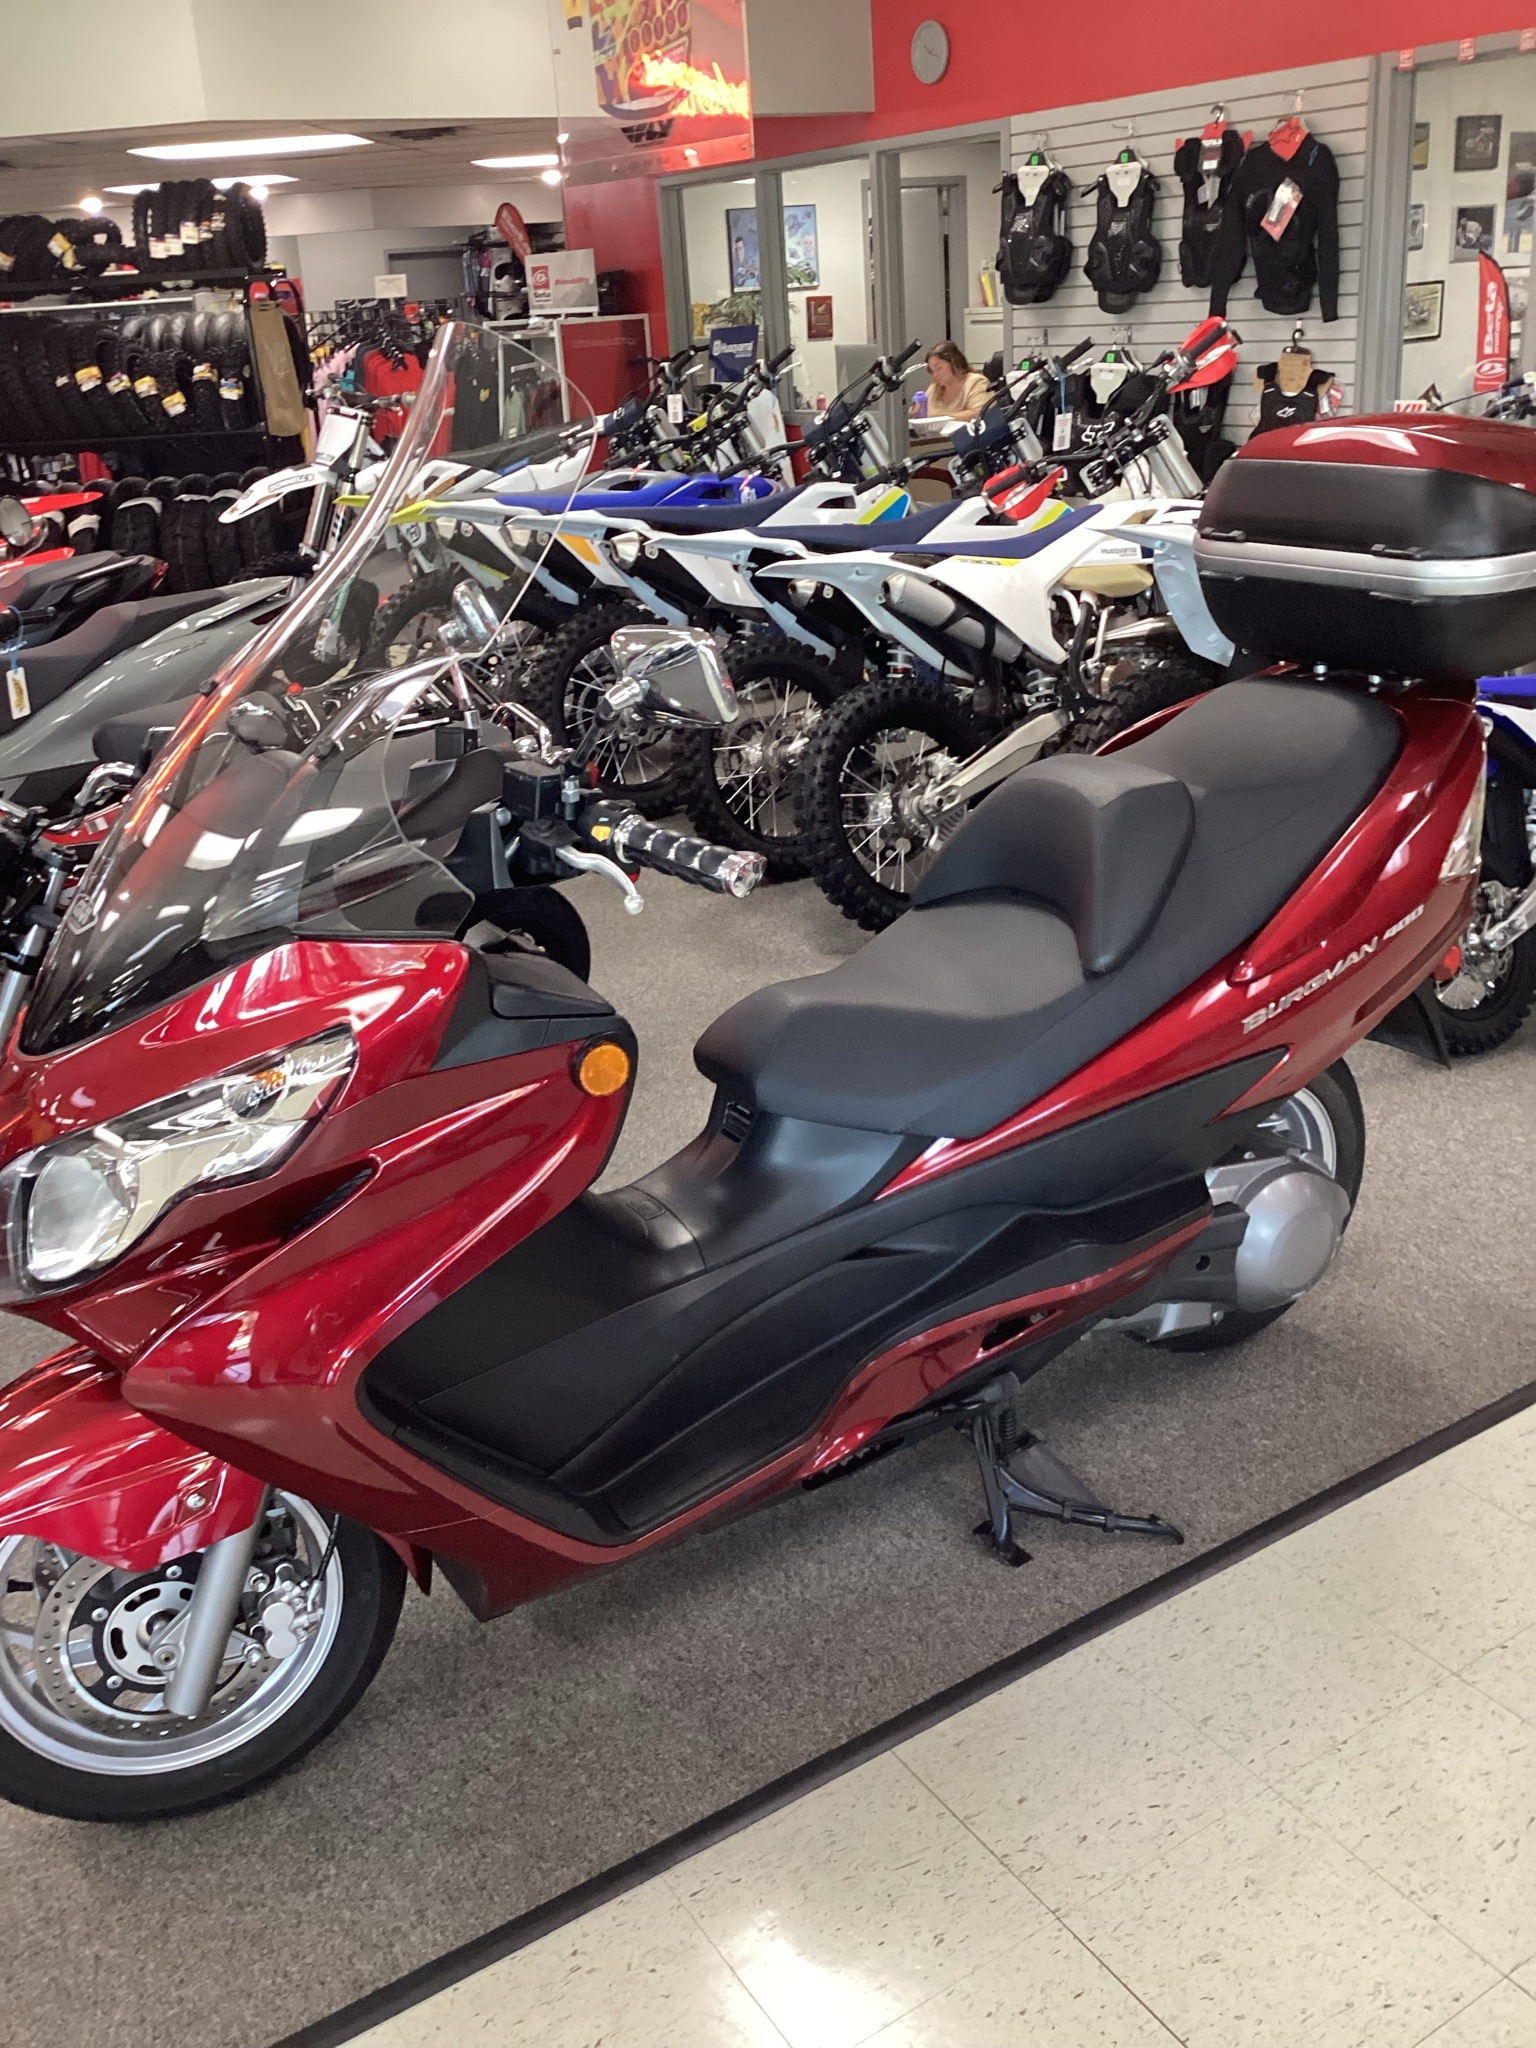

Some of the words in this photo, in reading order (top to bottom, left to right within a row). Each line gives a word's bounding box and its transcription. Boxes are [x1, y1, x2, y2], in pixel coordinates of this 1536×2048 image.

[1483, 281, 1498, 355] Beta
[1241, 936, 1379, 1034] BURGMAN
[1382, 904, 1425, 940] 400
